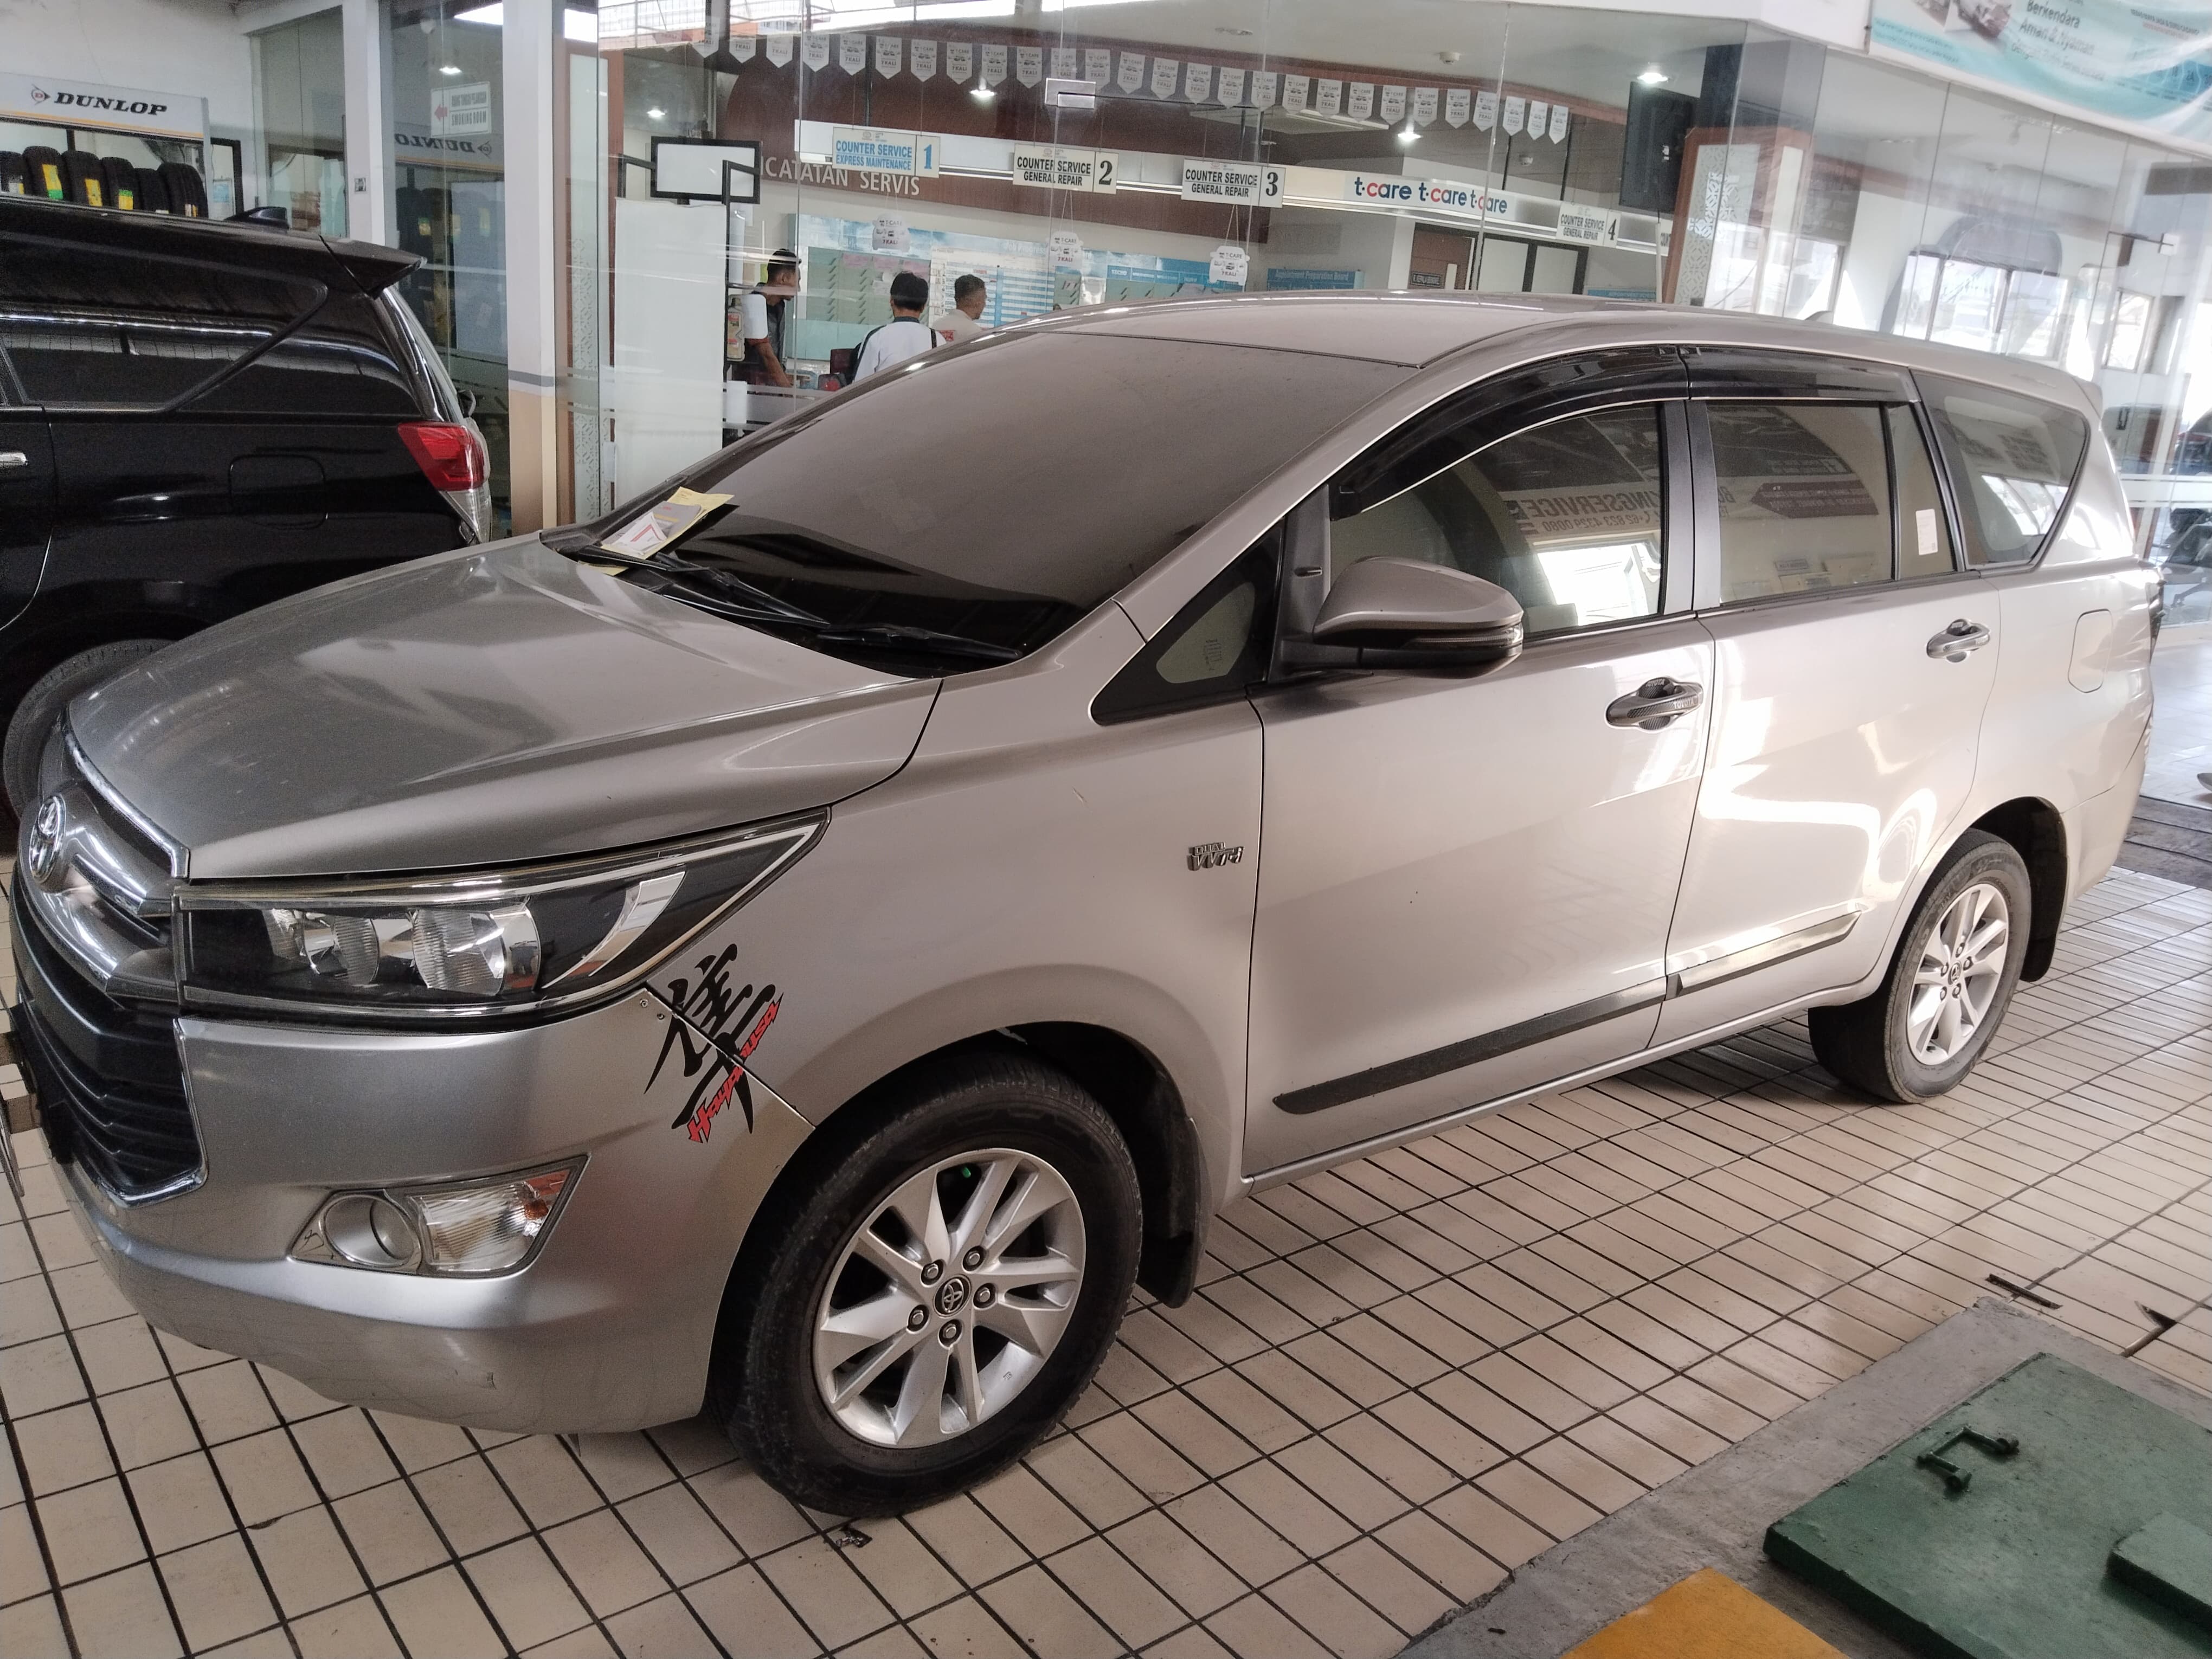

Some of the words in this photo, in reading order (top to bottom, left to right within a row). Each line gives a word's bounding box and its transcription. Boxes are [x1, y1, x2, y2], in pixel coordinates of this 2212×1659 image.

[2027, 0, 2081, 28] Berkendara
[54, 92, 168, 115] DUNLOP
[451, 112, 472, 126] SMOKING
[473, 110, 487, 125] ROOM
[835, 140, 875, 155] COUNTER
[877, 144, 912, 158] SERVICE
[923, 144, 933, 170] 1
[836, 156, 864, 166] EXPRESS
[866, 157, 911, 171] MAINTENANCE
[1017, 156, 1054, 171] COUNTER
[1057, 160, 1091, 175] SERVICE
[1098, 160, 1113, 185] 2
[1024, 171, 1056, 183] GENERAL
[1058, 174, 1082, 186] REPAIR
[860, 171, 920, 196] SERVIS
[1185, 169, 1223, 183] COUNTER
[1224, 172, 1258, 186] SERVICE
[1265, 172, 1278, 196] 3
[1192, 183, 1223, 195] GENERAL
[1225, 186, 1249, 197] REPAIR
[1560, 214, 1584, 228] COUNTER
[1584, 218, 1605, 230] SERVICE
[1607, 218, 1617, 240] 4
[1563, 227, 1583, 239] GENERAL
[1584, 232, 1598, 241] REPAIR
[1673, 697, 1694, 710] TOYOTA
